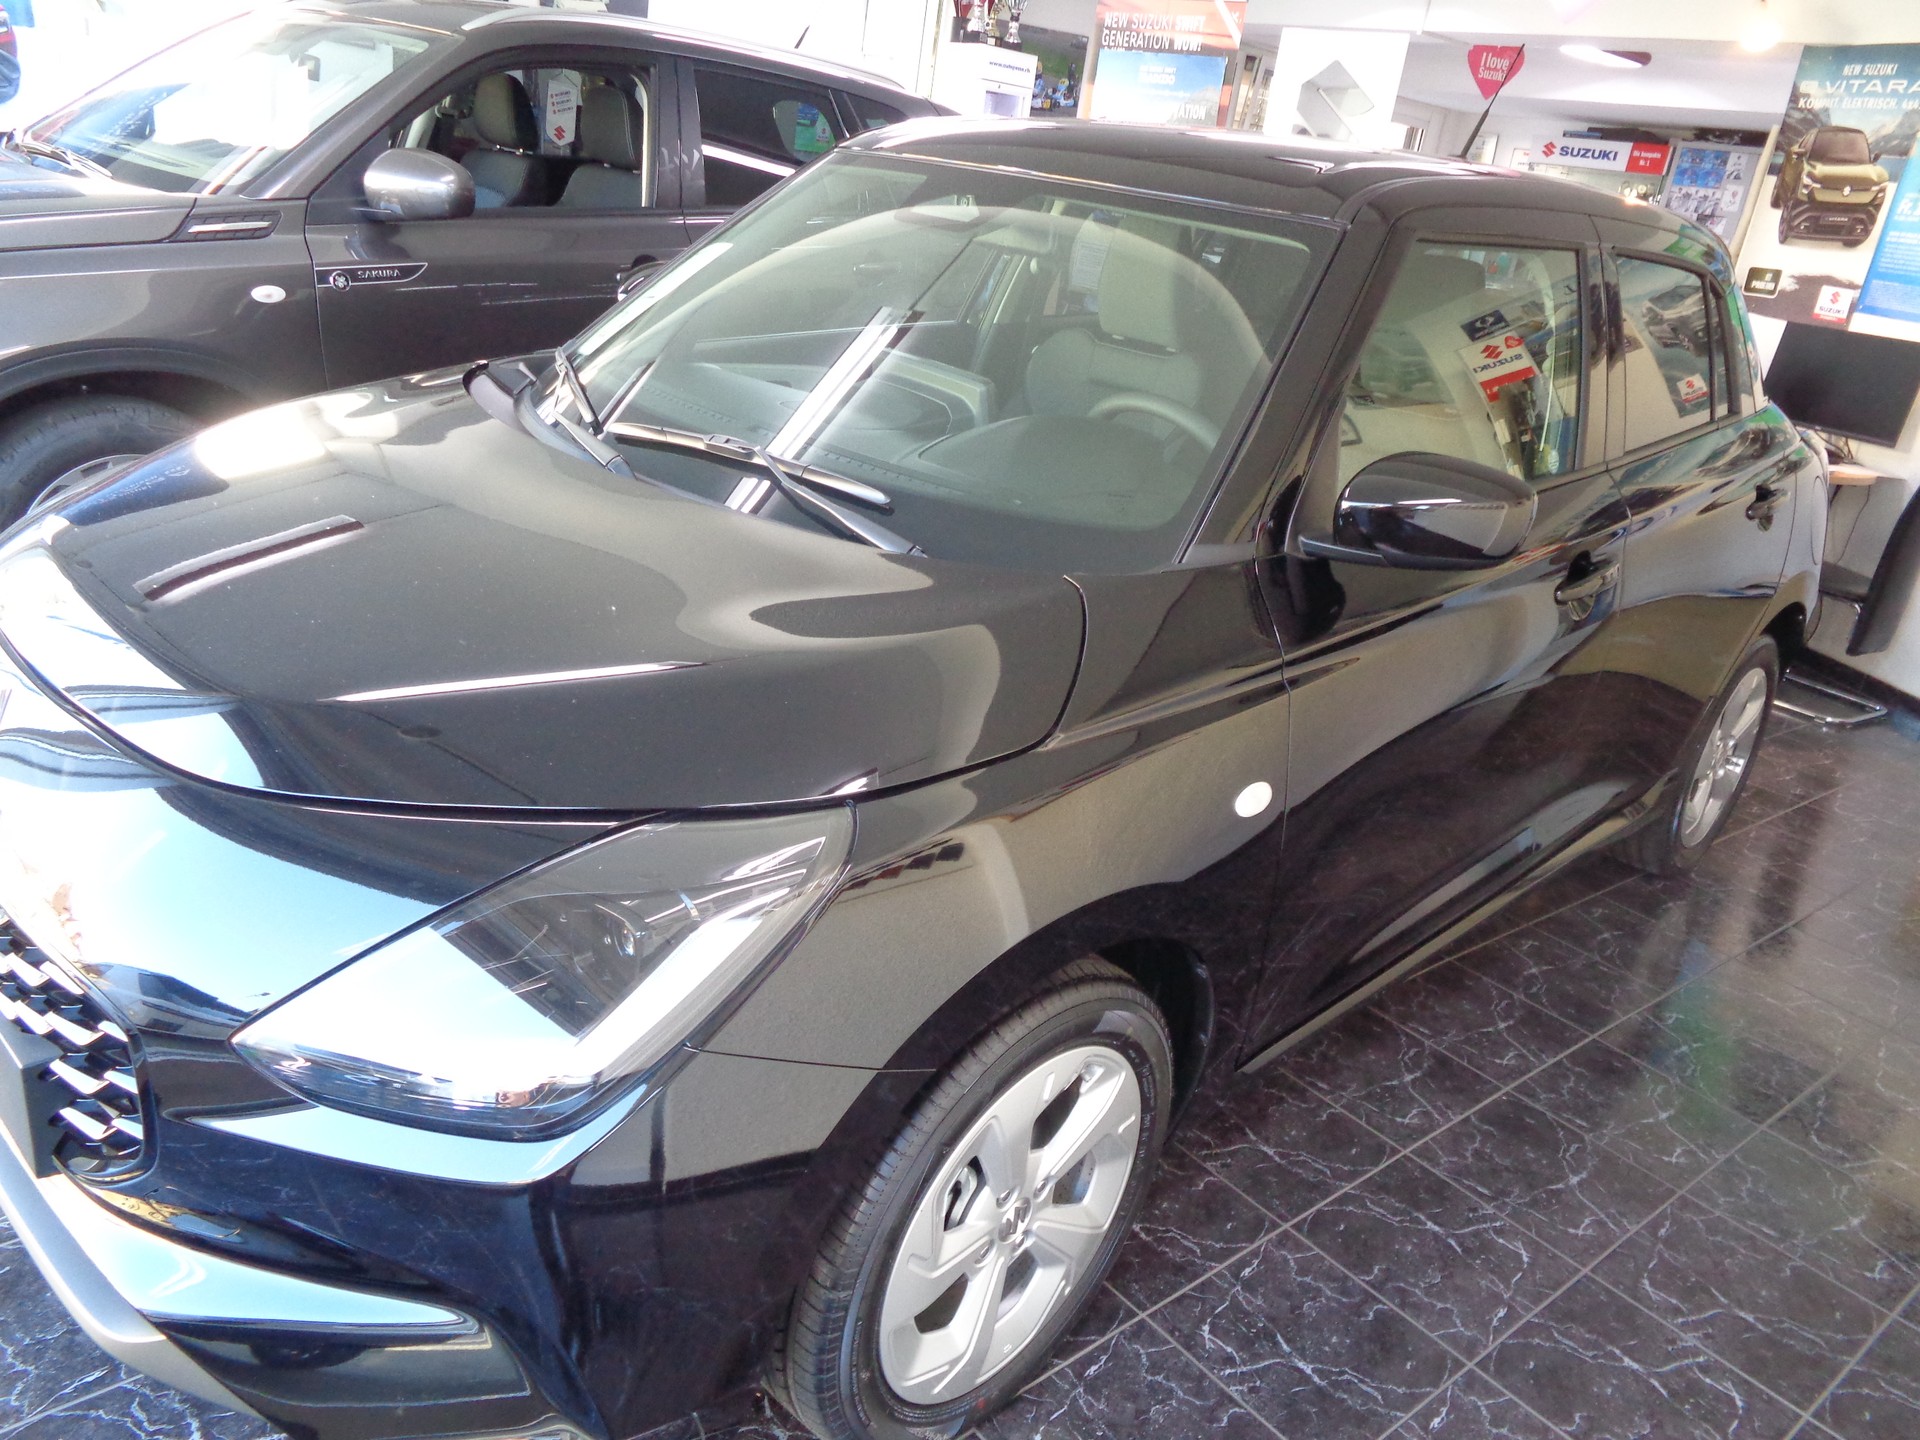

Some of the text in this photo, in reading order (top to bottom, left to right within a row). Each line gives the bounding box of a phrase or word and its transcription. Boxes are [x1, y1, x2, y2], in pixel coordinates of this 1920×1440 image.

[1104, 12, 1205, 32] NEW SUZUKI SWIFT
[1102, 29, 1202, 51] GENERATION WOW!
[1486, 53, 1509, 70] love
[1479, 67, 1507, 82] Suzuki
[1842, 64, 1898, 76] NEW SUZUKI
[1826, 79, 1920, 94] VITARA
[1559, 146, 1618, 161] SUZUKI
[357, 269, 400, 279] SAKURA
